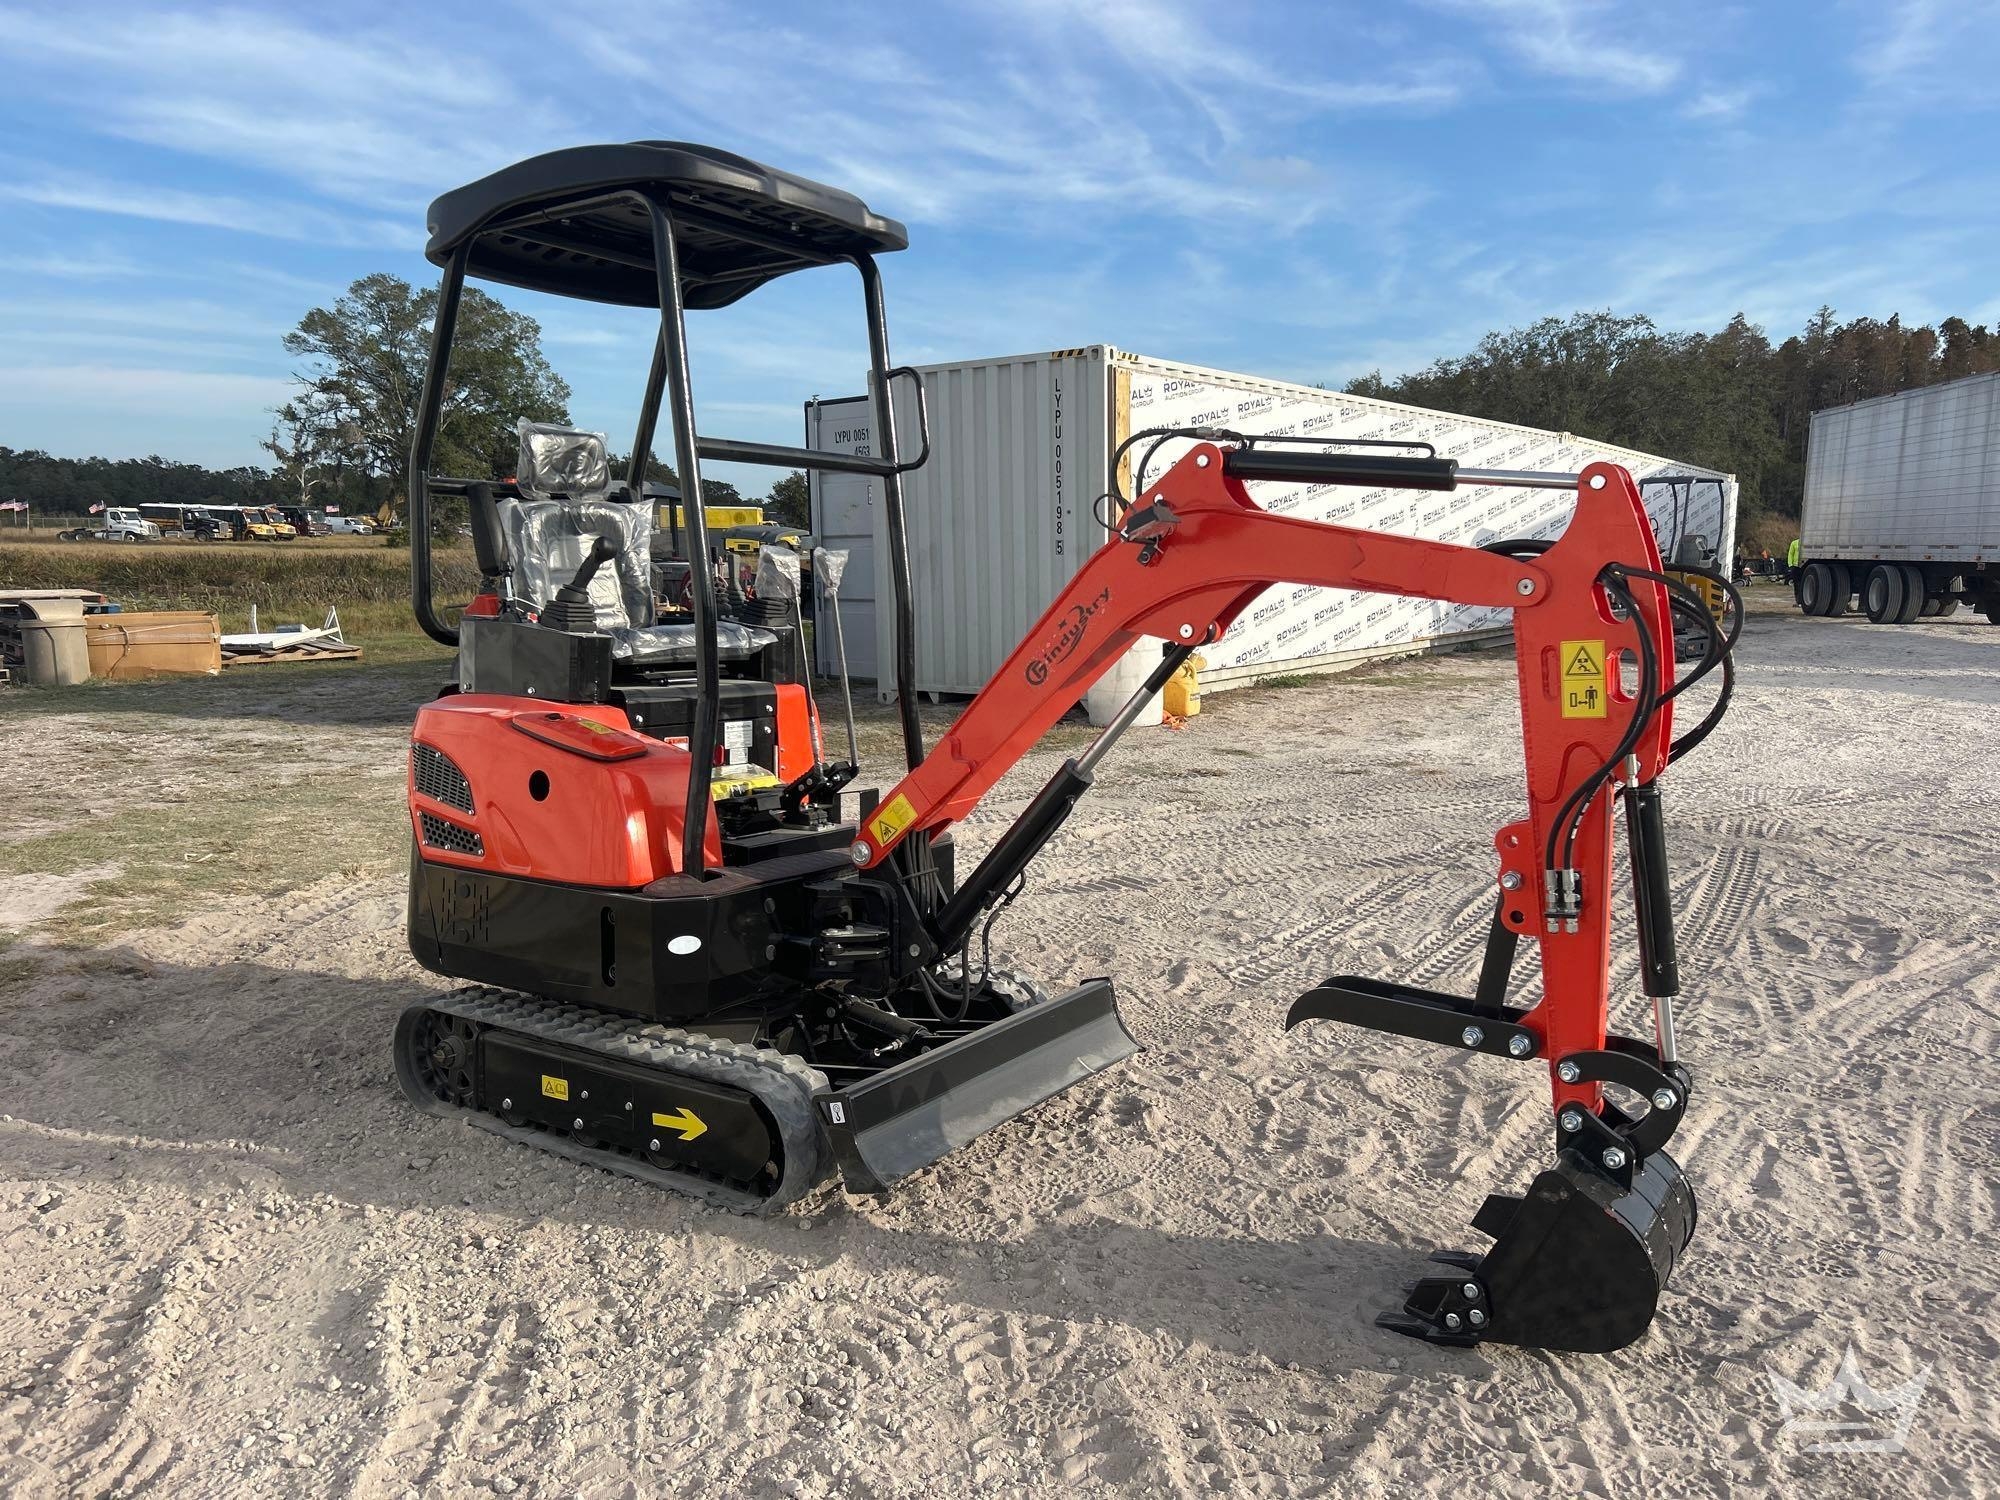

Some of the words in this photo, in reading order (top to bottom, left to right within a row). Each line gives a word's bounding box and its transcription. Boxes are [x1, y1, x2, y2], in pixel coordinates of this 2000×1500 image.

[1165, 391, 1188, 401] AUCTION
[1237, 399, 1265, 412] ROYAL
[1191, 410, 1221, 426] ROYAL
[1239, 411, 1258, 420] AUCTION
[1302, 416, 1327, 429] ROYAL
[1390, 421, 1409, 432] ROYAL
[834, 430, 851, 444] LYPU
[1267, 495, 1292, 510] ROYAL
[1361, 492, 1381, 505] ROYAL
[1450, 497, 1466, 508] ROYAL
[1326, 505, 1349, 519] ROYAL
[1423, 508, 1440, 521] ROYAL
[1380, 513, 1399, 527] ROYAL
[1464, 517, 1479, 528] ROYAL
[1439, 530, 1455, 541] ROYAL
[1292, 585, 1316, 600] ROYAL
[1253, 604, 1278, 621] ROYAL
[1314, 605, 1337, 621] ROYAL
[1366, 608, 1387, 622] ROYAL
[1277, 625, 1301, 641] ROYAL
[1333, 626, 1355, 642] ROYAL
[1385, 627, 1405, 641] ROYAL
[1235, 646, 1262, 665] ROYAL
